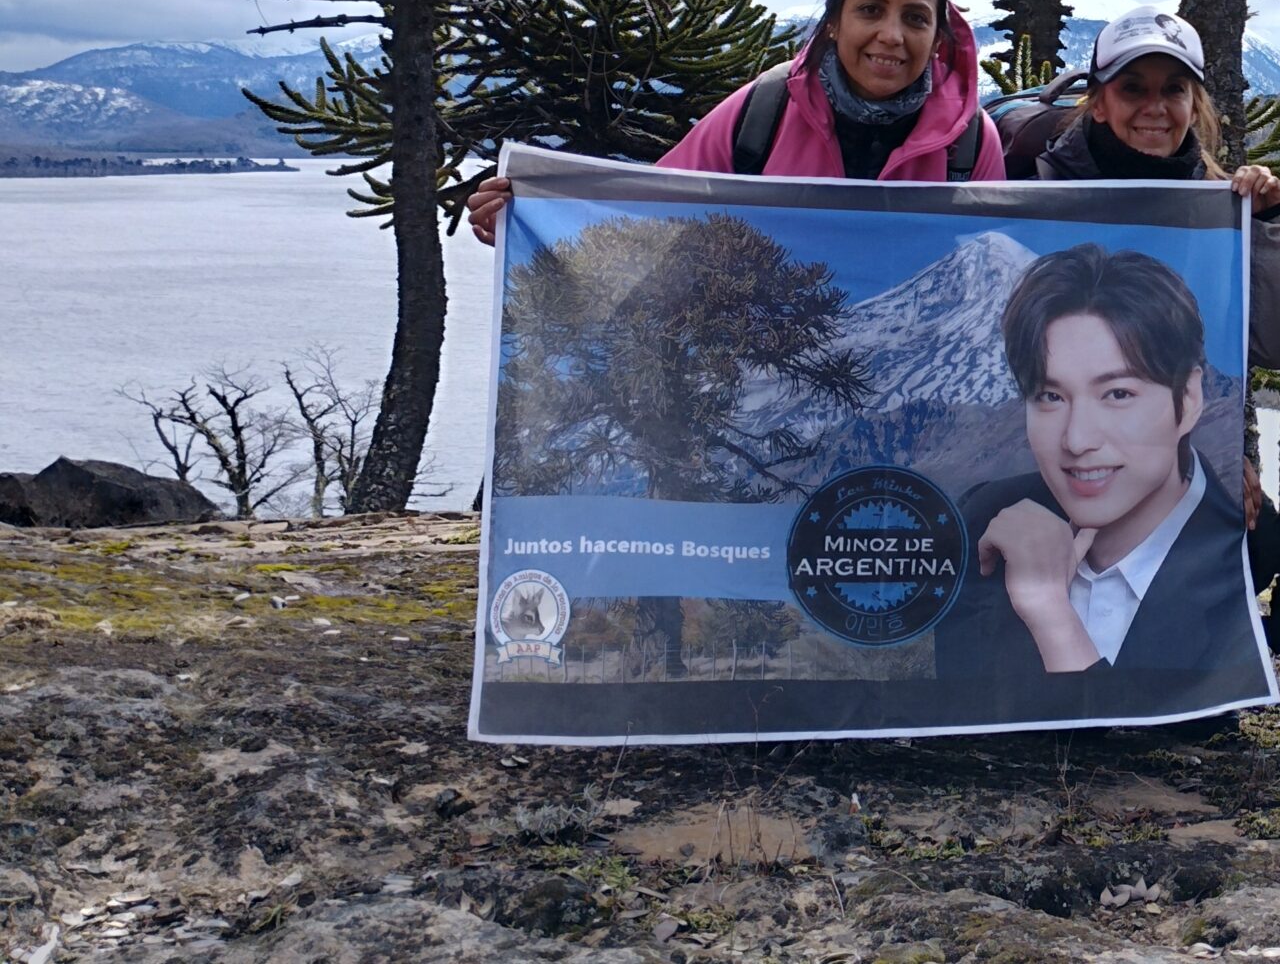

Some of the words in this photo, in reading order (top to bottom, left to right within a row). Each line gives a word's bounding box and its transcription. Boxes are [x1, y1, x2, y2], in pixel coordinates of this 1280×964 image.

[504, 538, 573, 555] Juntos
[579, 536, 675, 555] hacemos
[681, 541, 771, 563] Bosques
[824, 535, 898, 552] MINOZ
[905, 538, 934, 552] DE
[794, 558, 956, 576] ARGENTINA
[516, 643, 541, 654] AAP
